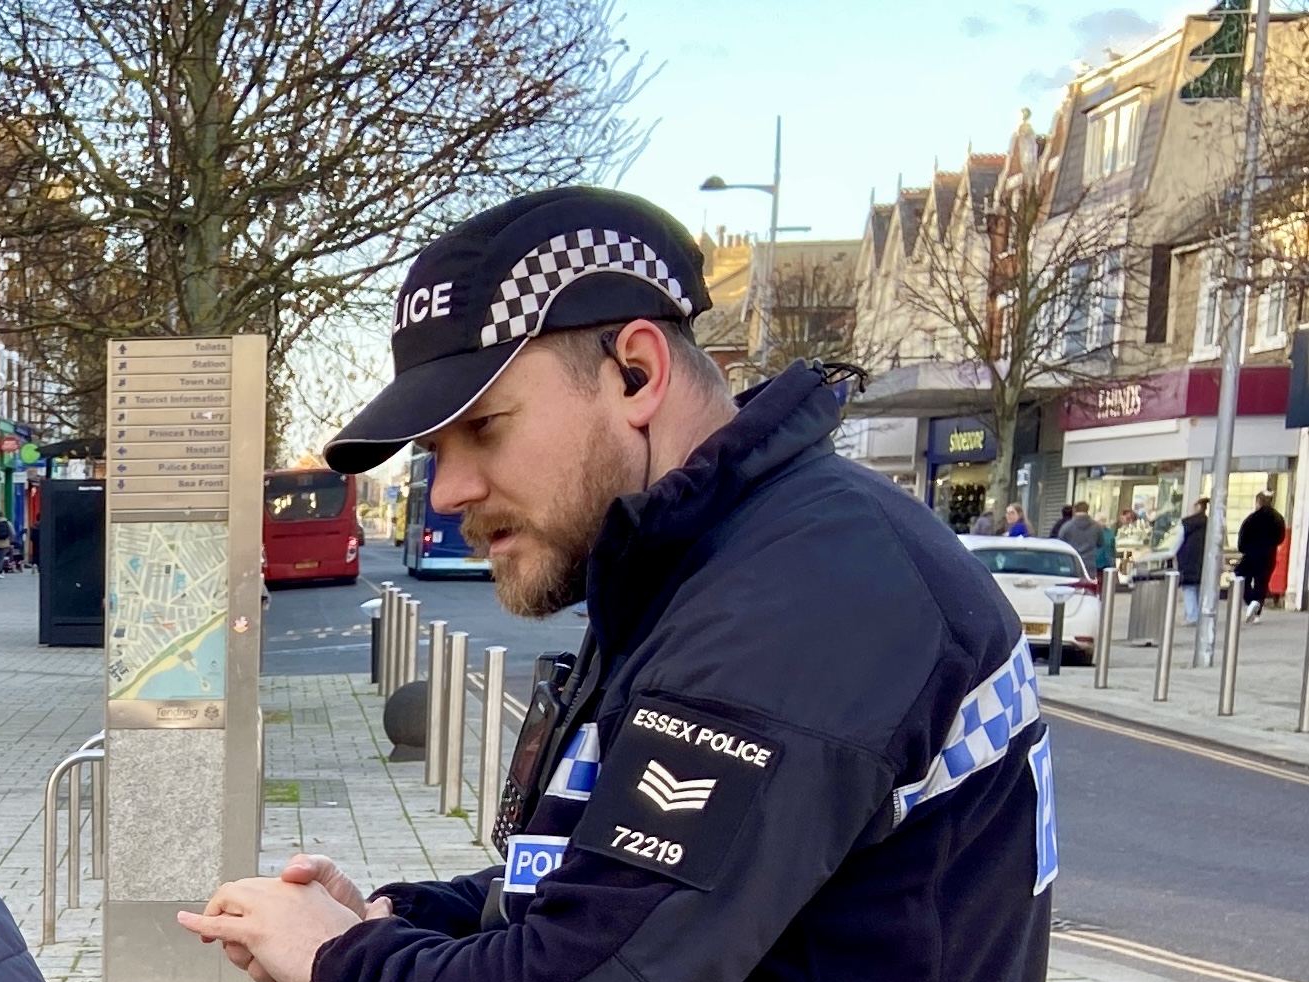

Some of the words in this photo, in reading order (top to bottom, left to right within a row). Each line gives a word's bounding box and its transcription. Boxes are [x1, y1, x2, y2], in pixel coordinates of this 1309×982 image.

[195, 343, 226, 351] Toilets
[192, 361, 226, 369] Station
[179, 378, 204, 386] Town
[135, 396, 168, 404] Tourist
[170, 394, 225, 403] Information
[191, 412, 224, 421] Libry
[149, 429, 184, 437] Princes
[188, 428, 224, 436] Theatre
[186, 446, 225, 455] Hospital
[158, 463, 187, 471] Police
[632, 708, 694, 743] ESSEX
[695, 727, 772, 768] POLICE
[610, 825, 684, 865] 72219
